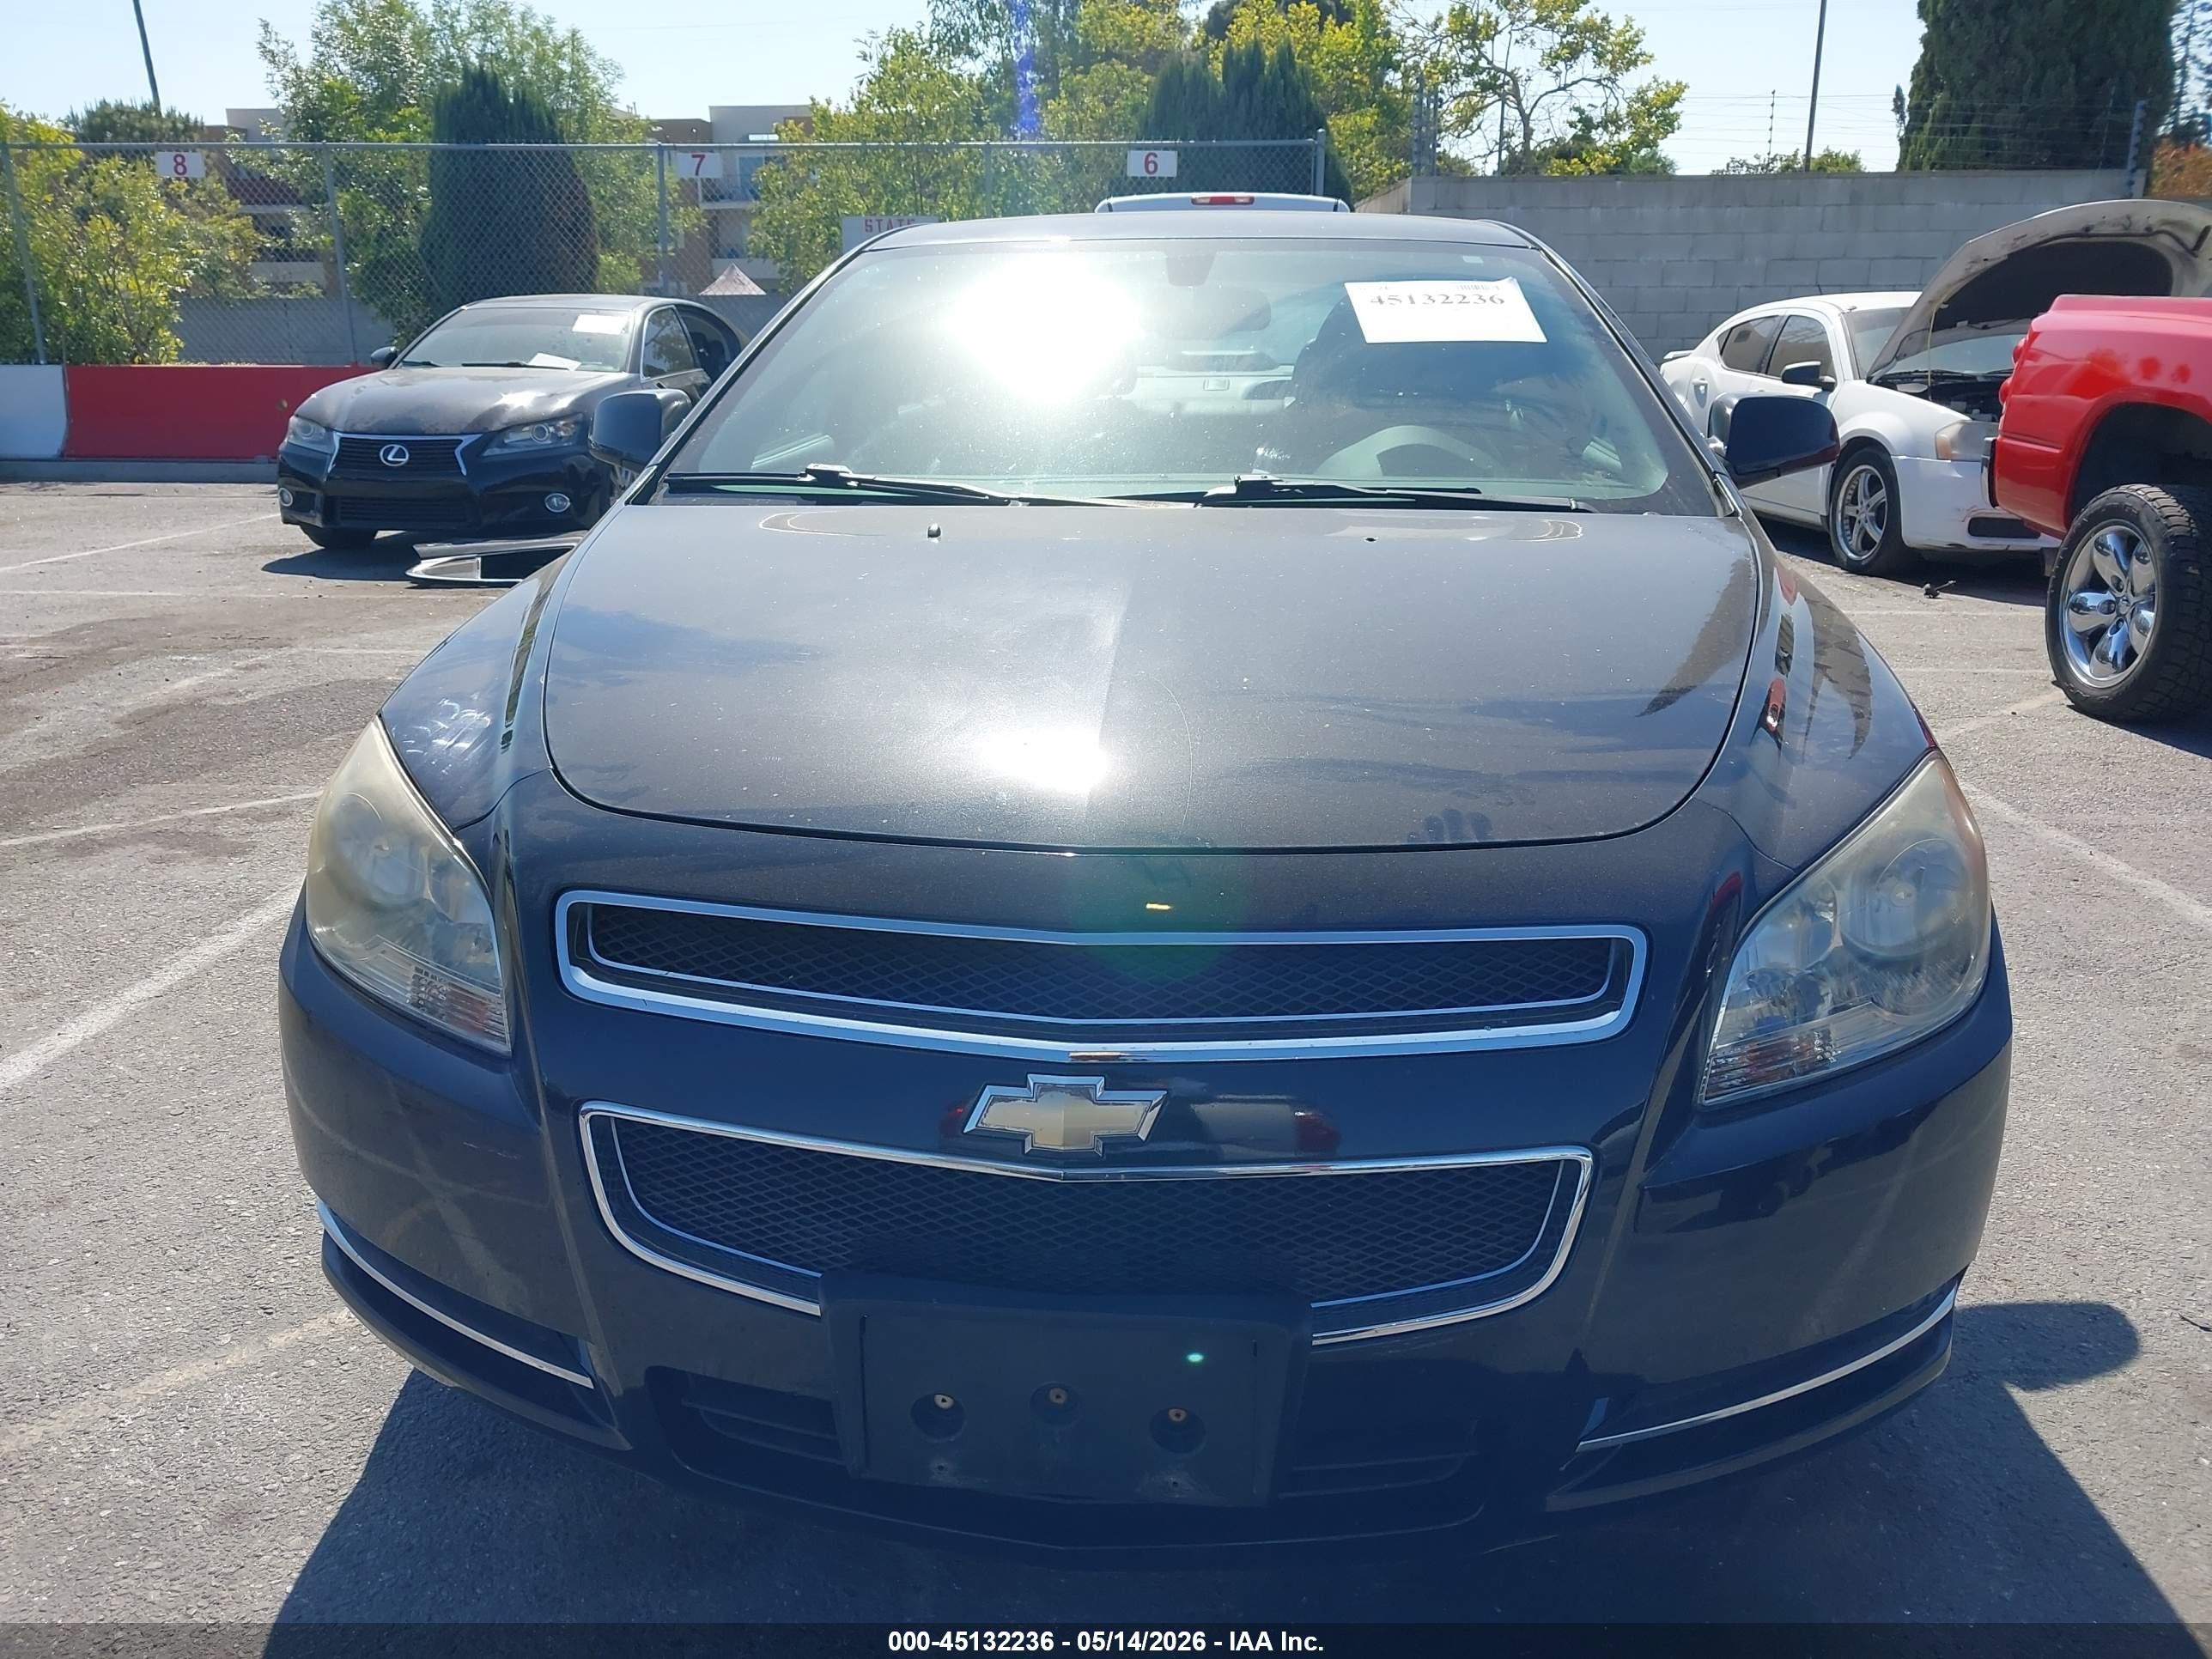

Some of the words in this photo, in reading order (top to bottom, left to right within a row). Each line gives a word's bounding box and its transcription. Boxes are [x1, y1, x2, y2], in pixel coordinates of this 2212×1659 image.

[173, 154, 187, 175] 8
[691, 154, 706, 176] 7
[1144, 152, 1158, 175] 6
[1370, 294, 1505, 306] 45132236
